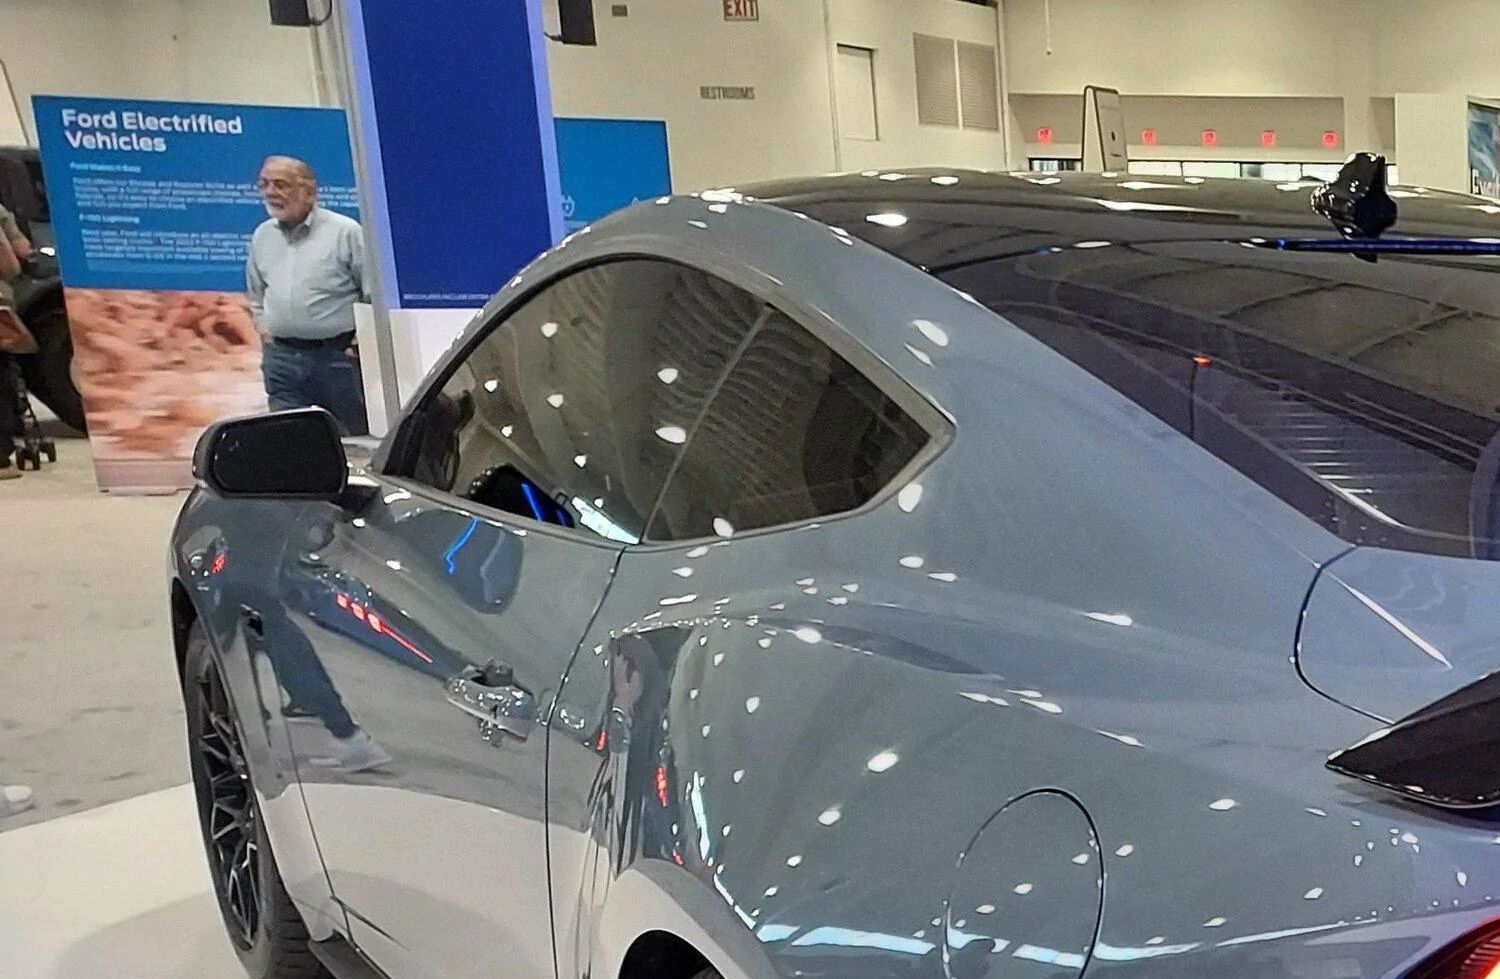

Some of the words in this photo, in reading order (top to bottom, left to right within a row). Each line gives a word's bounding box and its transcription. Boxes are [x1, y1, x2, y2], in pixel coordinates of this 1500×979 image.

[723, 0, 757, 17] EXIT
[61, 109, 118, 129] Ford
[122, 112, 243, 134] Electrified
[64, 130, 167, 152] Vehicles
